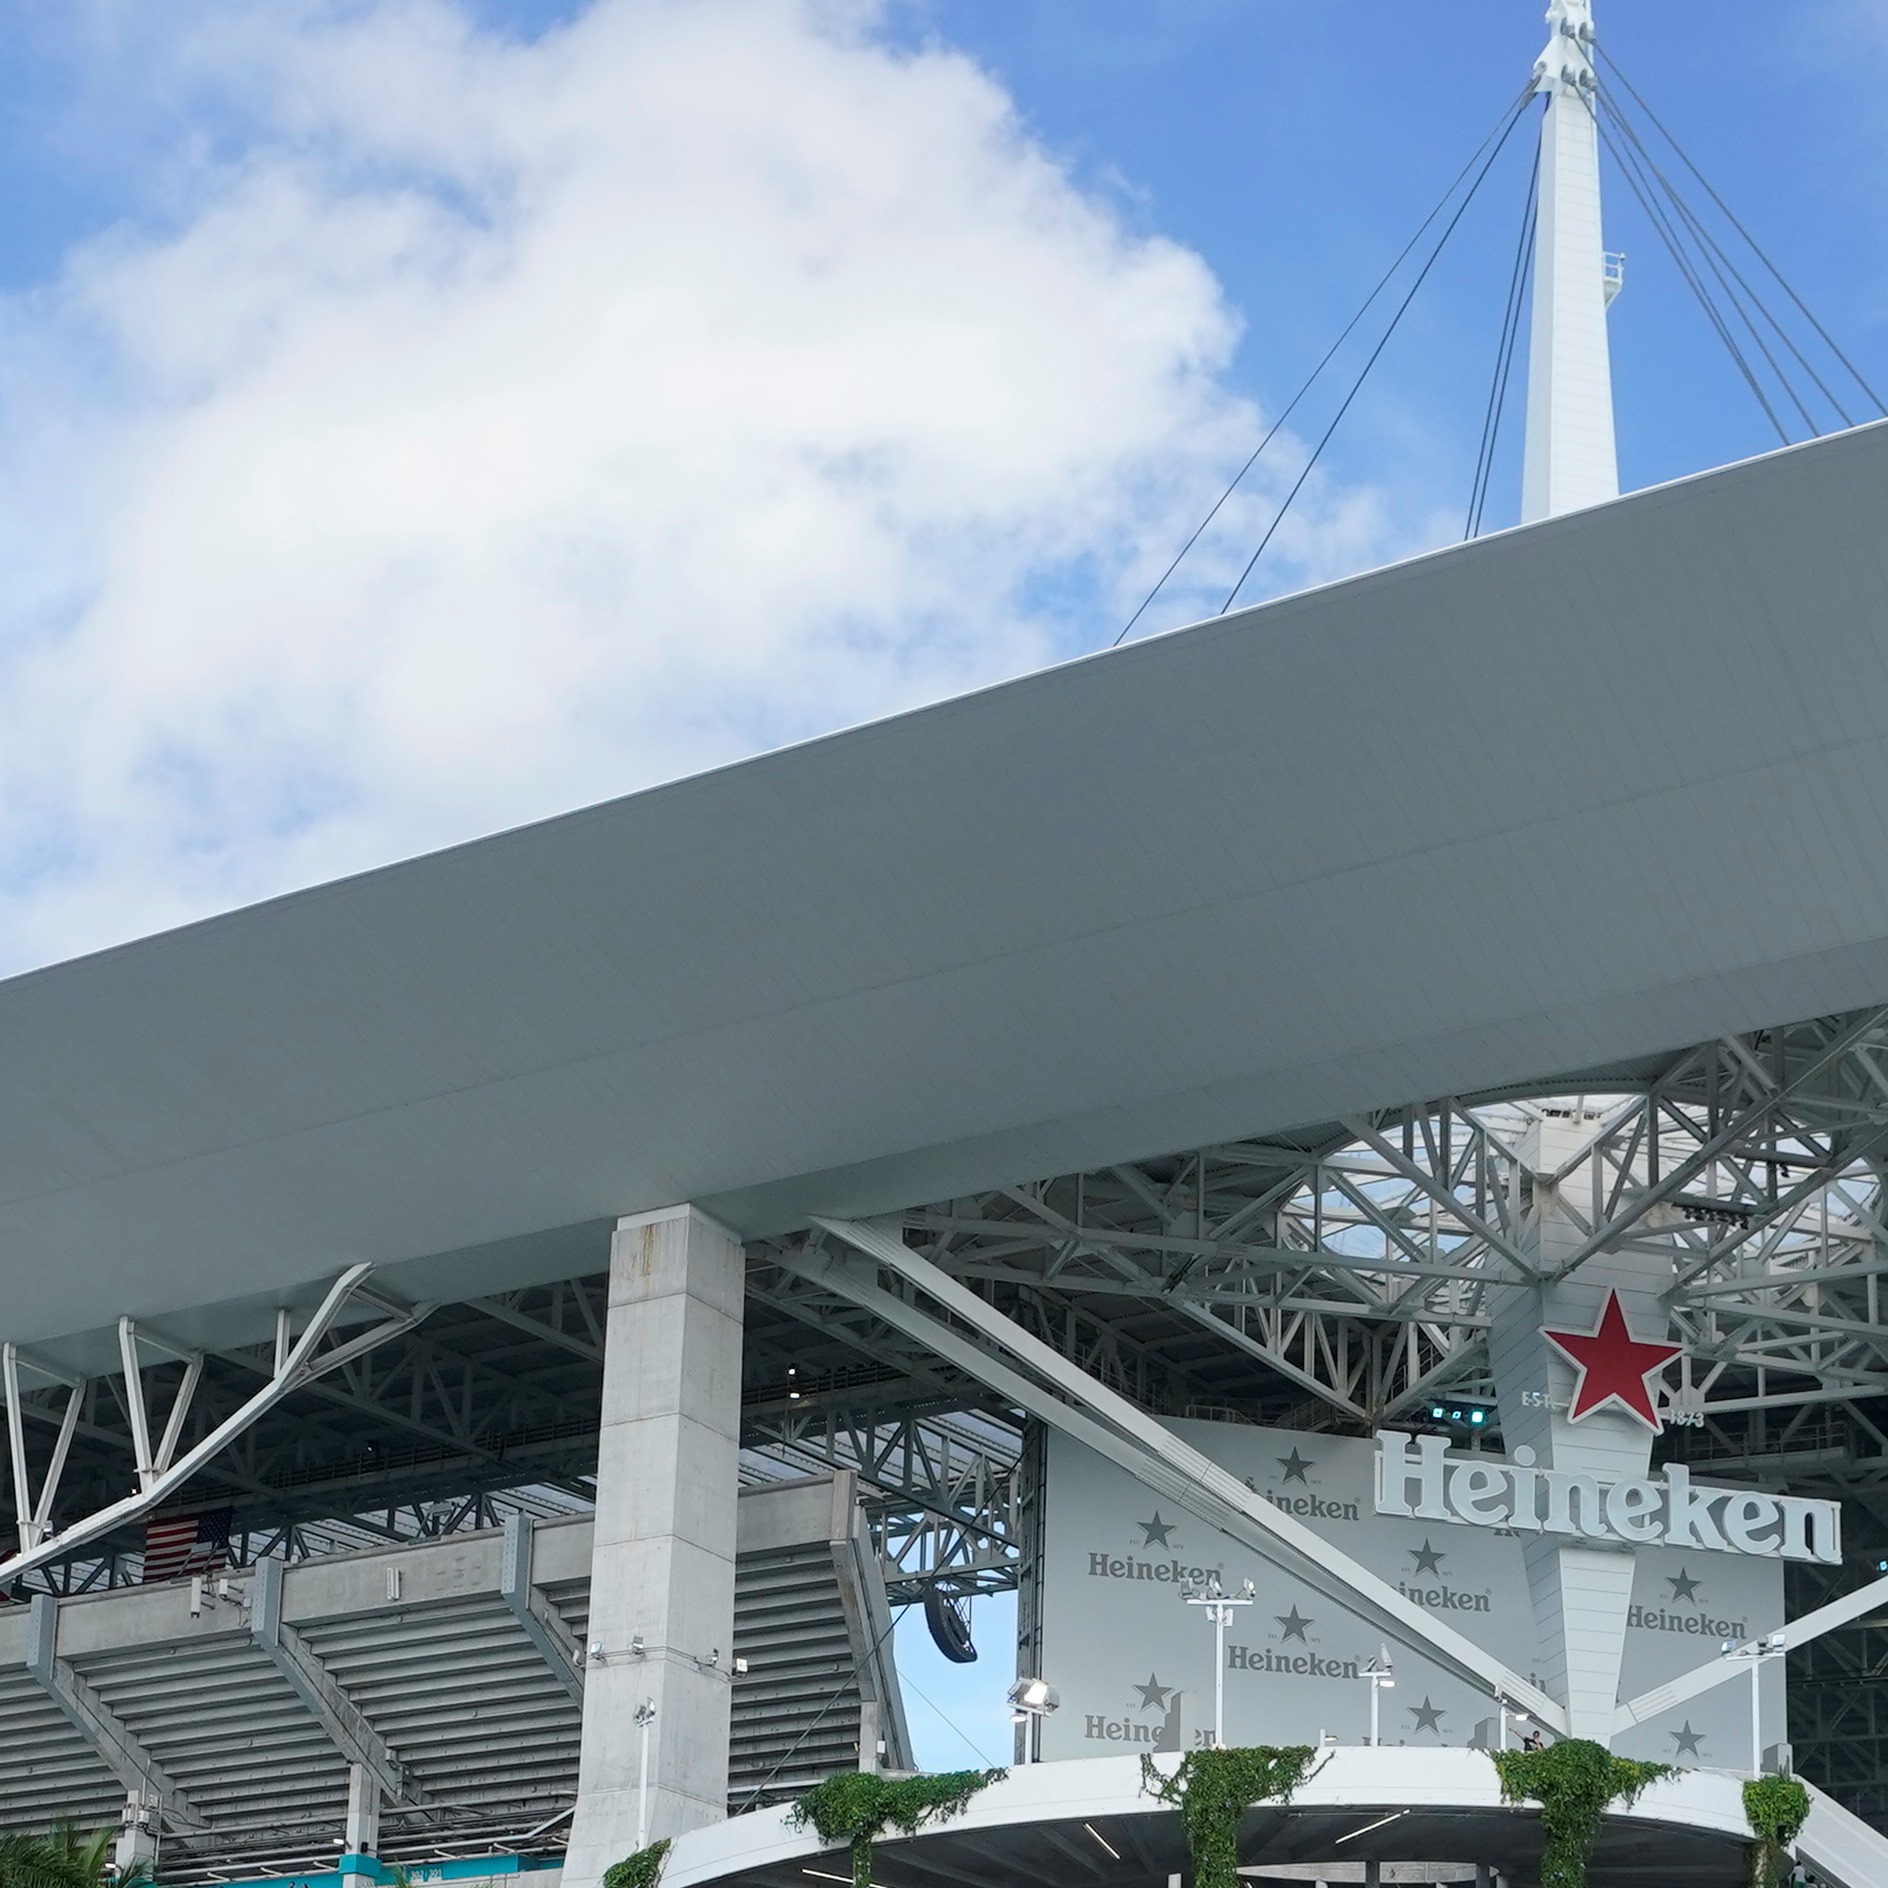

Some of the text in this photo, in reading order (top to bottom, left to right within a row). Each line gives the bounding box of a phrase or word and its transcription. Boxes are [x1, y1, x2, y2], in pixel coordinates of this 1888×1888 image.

[1375, 1430, 1843, 1563] Heineken
[1088, 1552, 1222, 1587] Heineken
[1626, 1605, 1747, 1640] Heineken
[1227, 1645, 1360, 1679] Heineken
